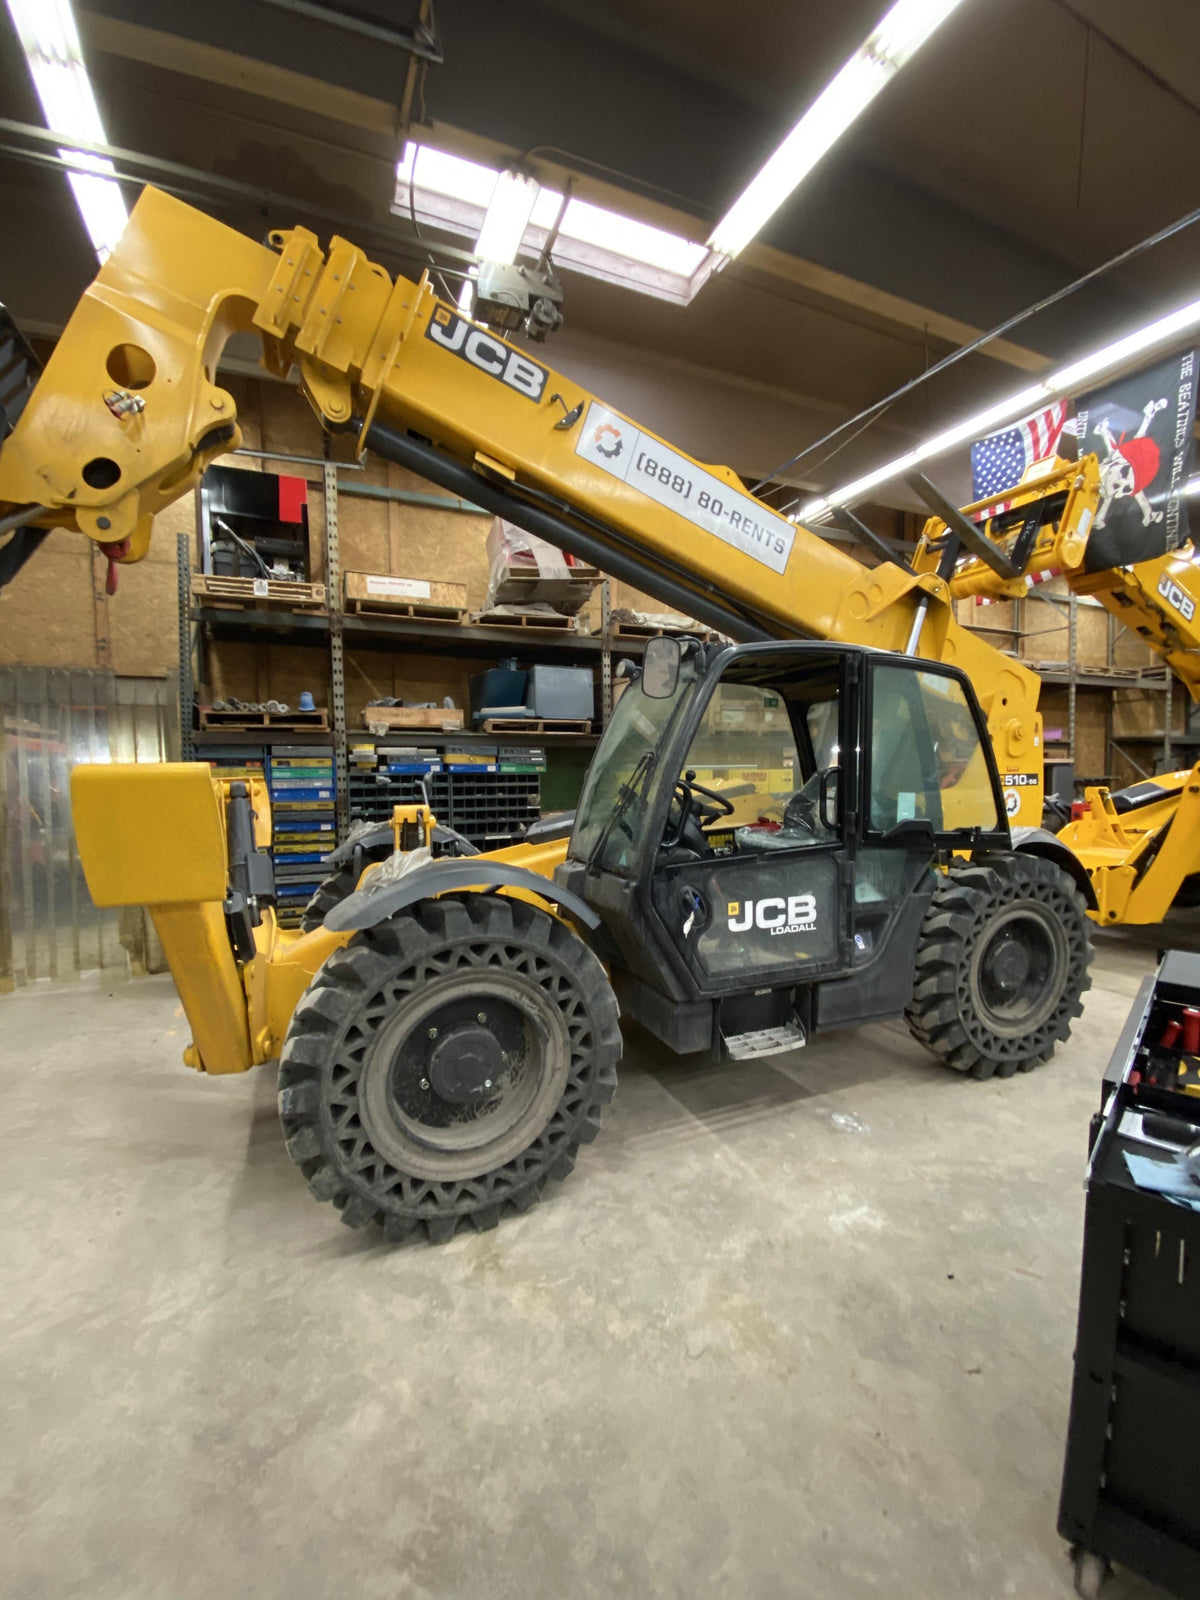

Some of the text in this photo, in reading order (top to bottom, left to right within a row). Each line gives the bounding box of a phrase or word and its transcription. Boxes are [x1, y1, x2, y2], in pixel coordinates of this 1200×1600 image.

[430, 319, 545, 398] JCB
[1180, 351, 1194, 379] THE
[1174, 383, 1192, 448] BEATINGS
[1171, 451, 1184, 489] WILL
[636, 452, 787, 555] (888) 80-RENTS
[1158, 580, 1195, 621] JCB
[728, 895, 817, 932] JCB
[770, 923, 817, 935] LOADALL
